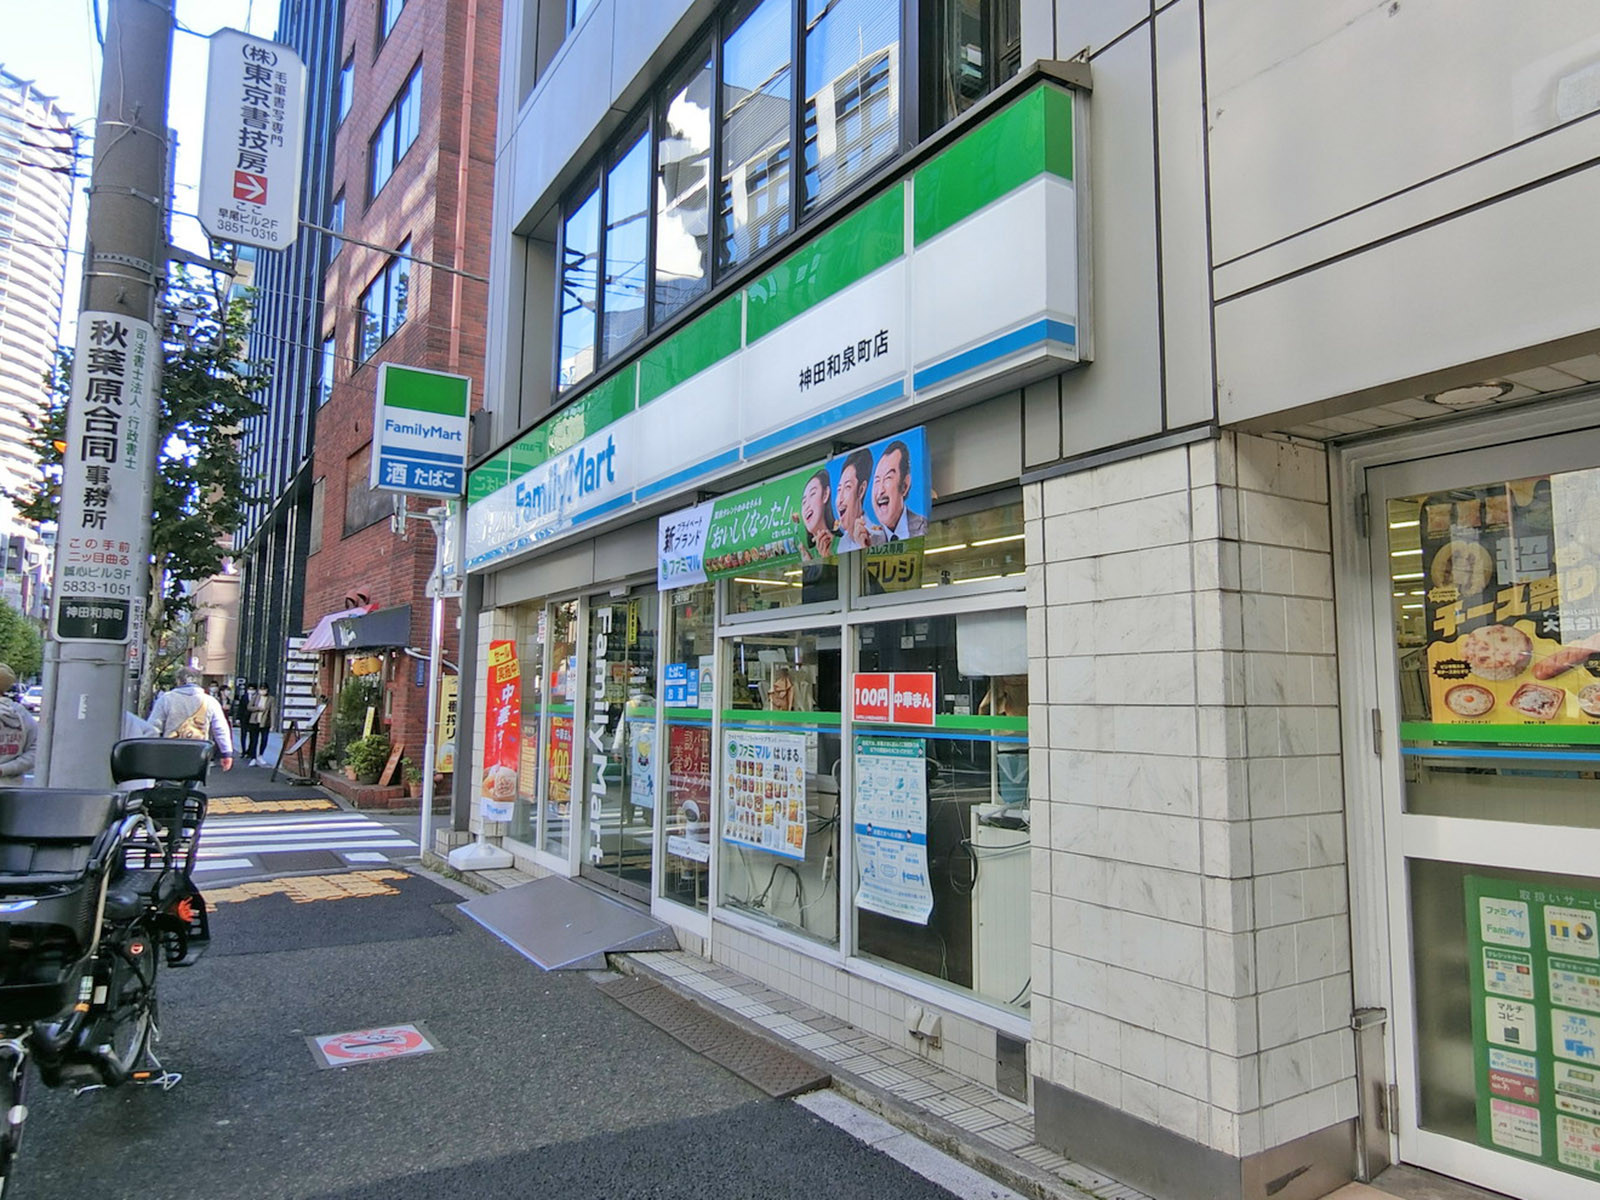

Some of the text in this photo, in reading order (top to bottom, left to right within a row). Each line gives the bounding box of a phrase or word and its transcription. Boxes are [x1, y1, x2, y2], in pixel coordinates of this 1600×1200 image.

[217, 219, 278, 242] 3851-0316
[798, 329, 889, 393] 神田和泉町店
[81, 319, 129, 530] 秋葉原合同事務所
[385, 418, 462, 441] FamilyMart
[385, 461, 456, 489] 酒 たばこ
[515, 433, 616, 527] FamilyMart
[69, 537, 131, 554] この手前
[662, 523, 676, 553] 新
[674, 530, 702, 550] ブランド
[669, 554, 700, 576] ファミマル
[63, 580, 132, 596] 5833-1051
[66, 605, 124, 621] 神田和泉町
[90, 622, 98, 635] 1
[855, 688, 888, 707] 100円
[894, 690, 932, 708] 中華まん
[588, 606, 613, 865] FamilyMart
[739, 743, 771, 760] ファミマル
[1485, 905, 1524, 919] ファミペイ
[1486, 924, 1526, 938] FamiPay
[1497, 1002, 1523, 1013] マルチ
[1498, 1011, 1524, 1022] コピー
